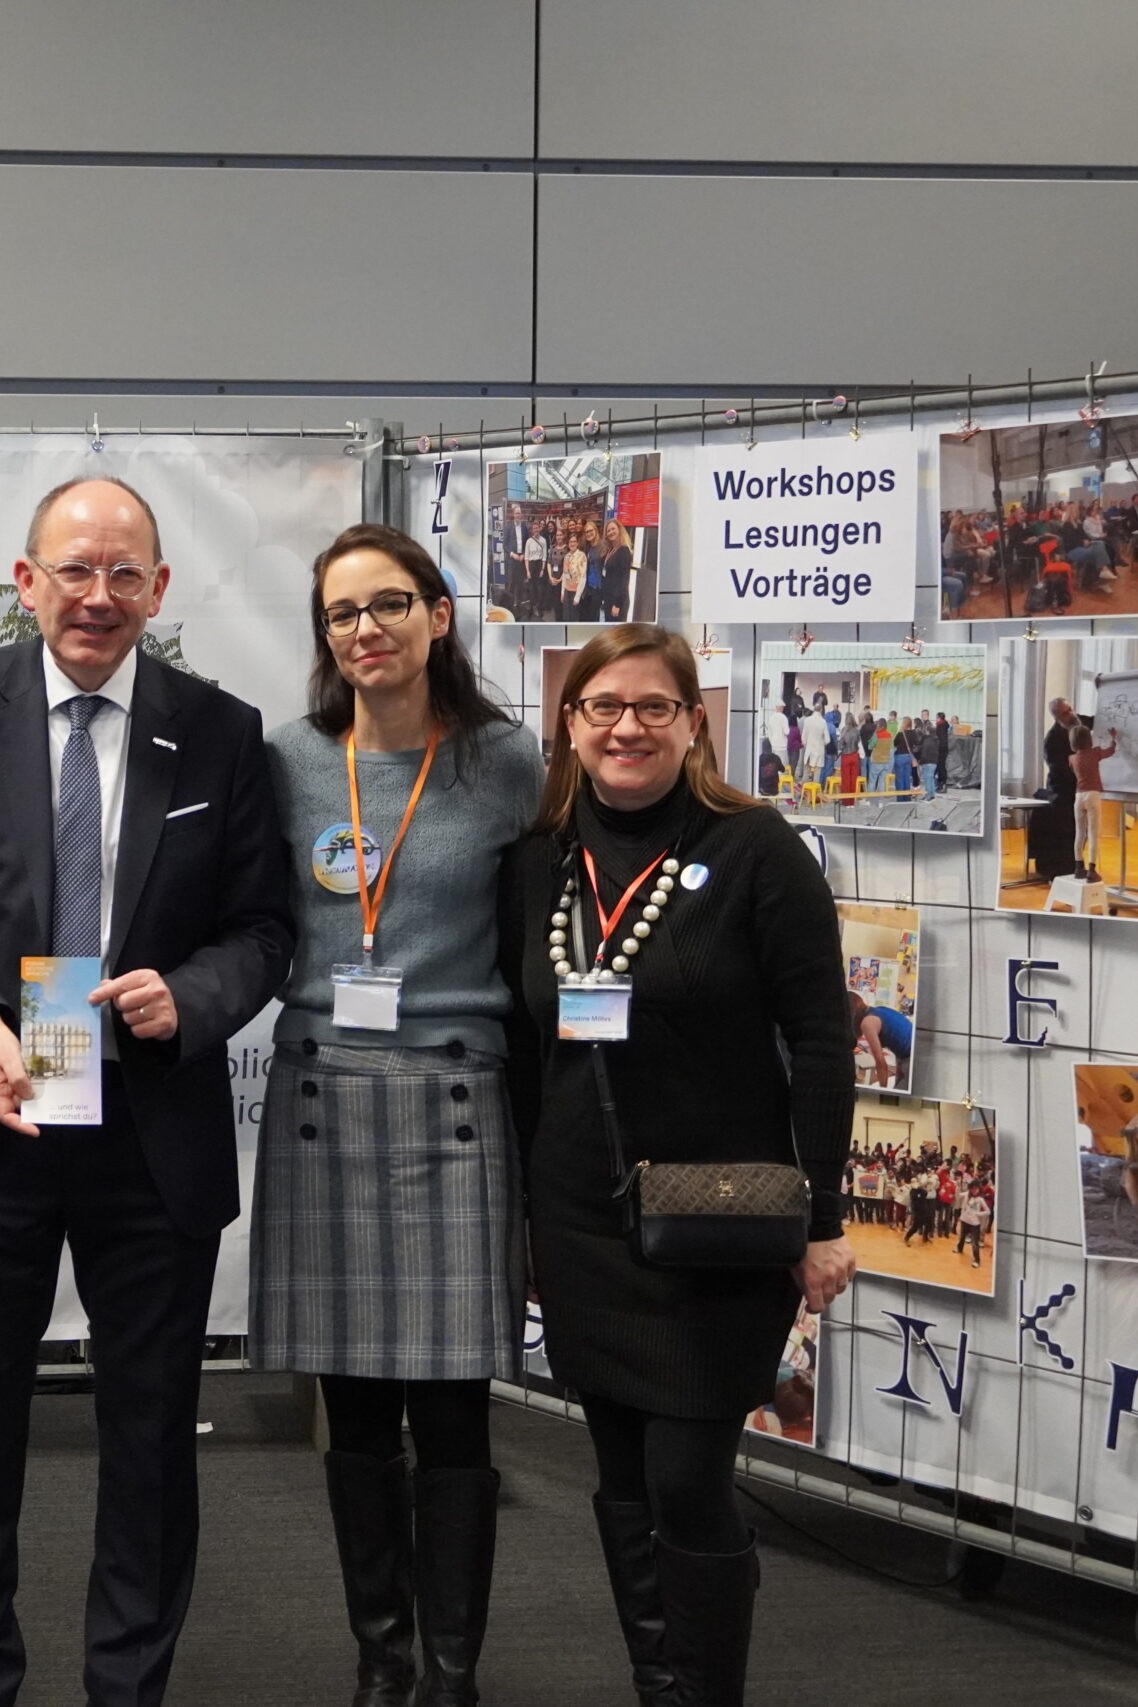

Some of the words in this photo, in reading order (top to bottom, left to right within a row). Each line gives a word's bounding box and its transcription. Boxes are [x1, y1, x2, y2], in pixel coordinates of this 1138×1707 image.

[713, 465, 896, 502] Workshops
[724, 519, 882, 555] Lesungen
[730, 566, 872, 605] Vorträge
[875, 1310, 968, 1416] N
